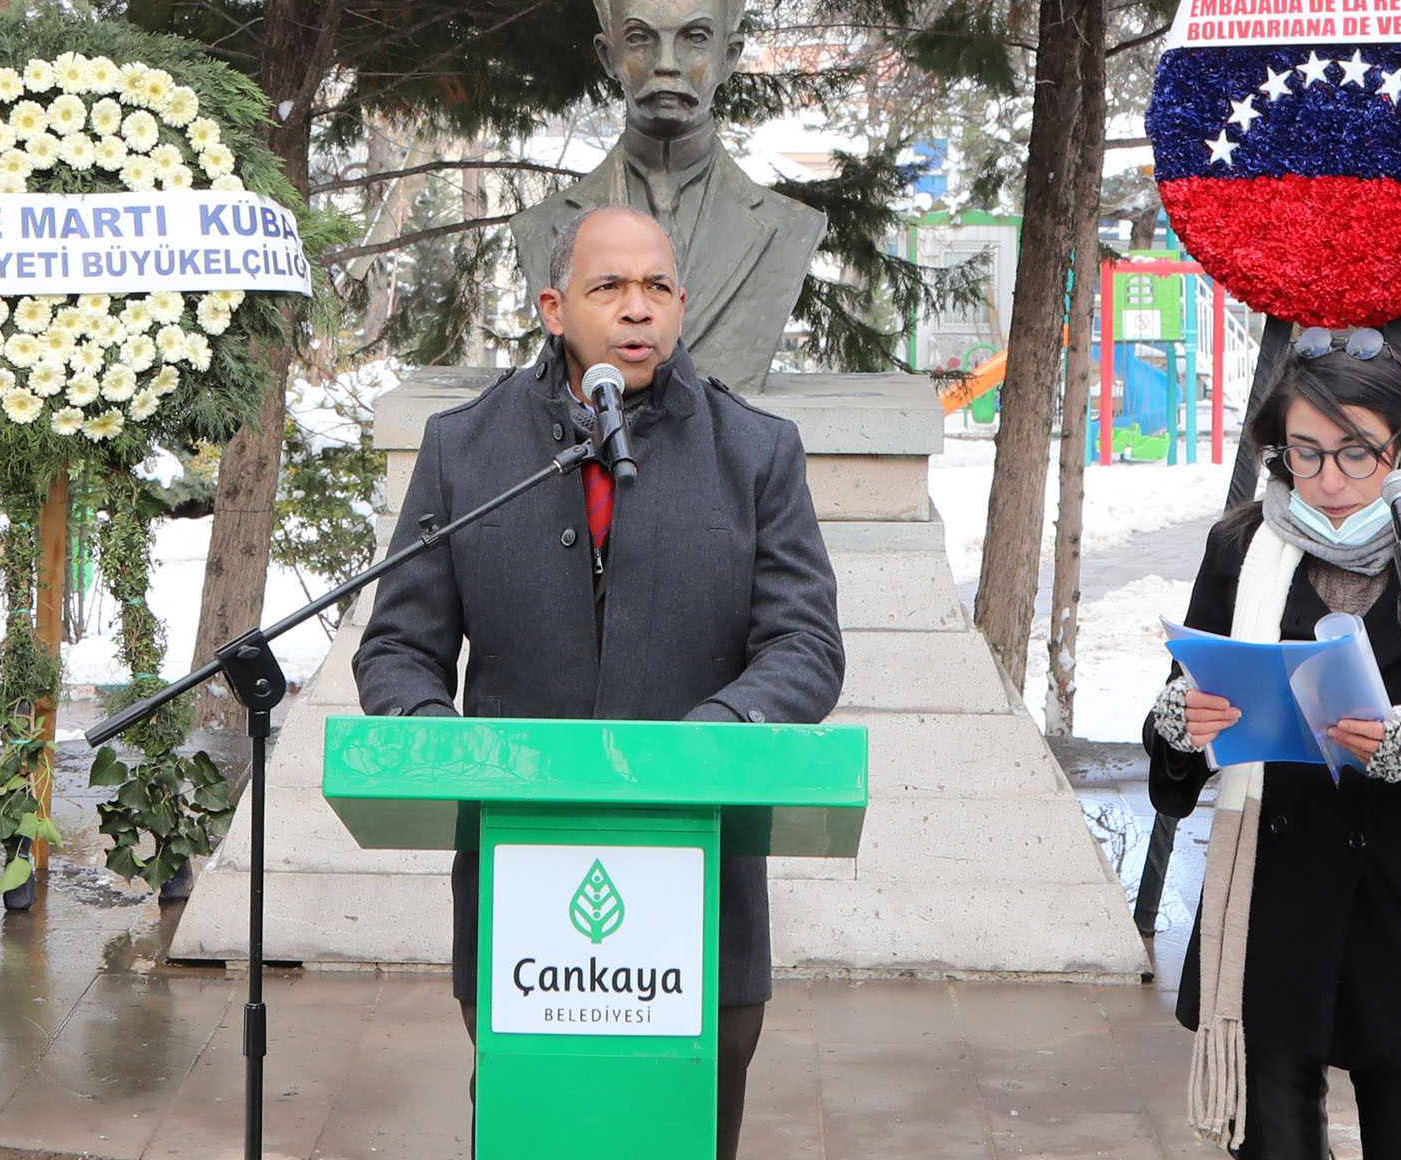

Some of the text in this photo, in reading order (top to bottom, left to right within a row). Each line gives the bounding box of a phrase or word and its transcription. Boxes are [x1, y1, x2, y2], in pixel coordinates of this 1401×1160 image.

[1187, 18, 1336, 41] BOLIVARIANA
[1343, 17, 1370, 36] DE
[20, 204, 167, 239] MARTI
[198, 199, 297, 242] KÜBA
[513, 957, 683, 1001] Çankaya
[544, 1005, 651, 1023] BELEDİYESİ
